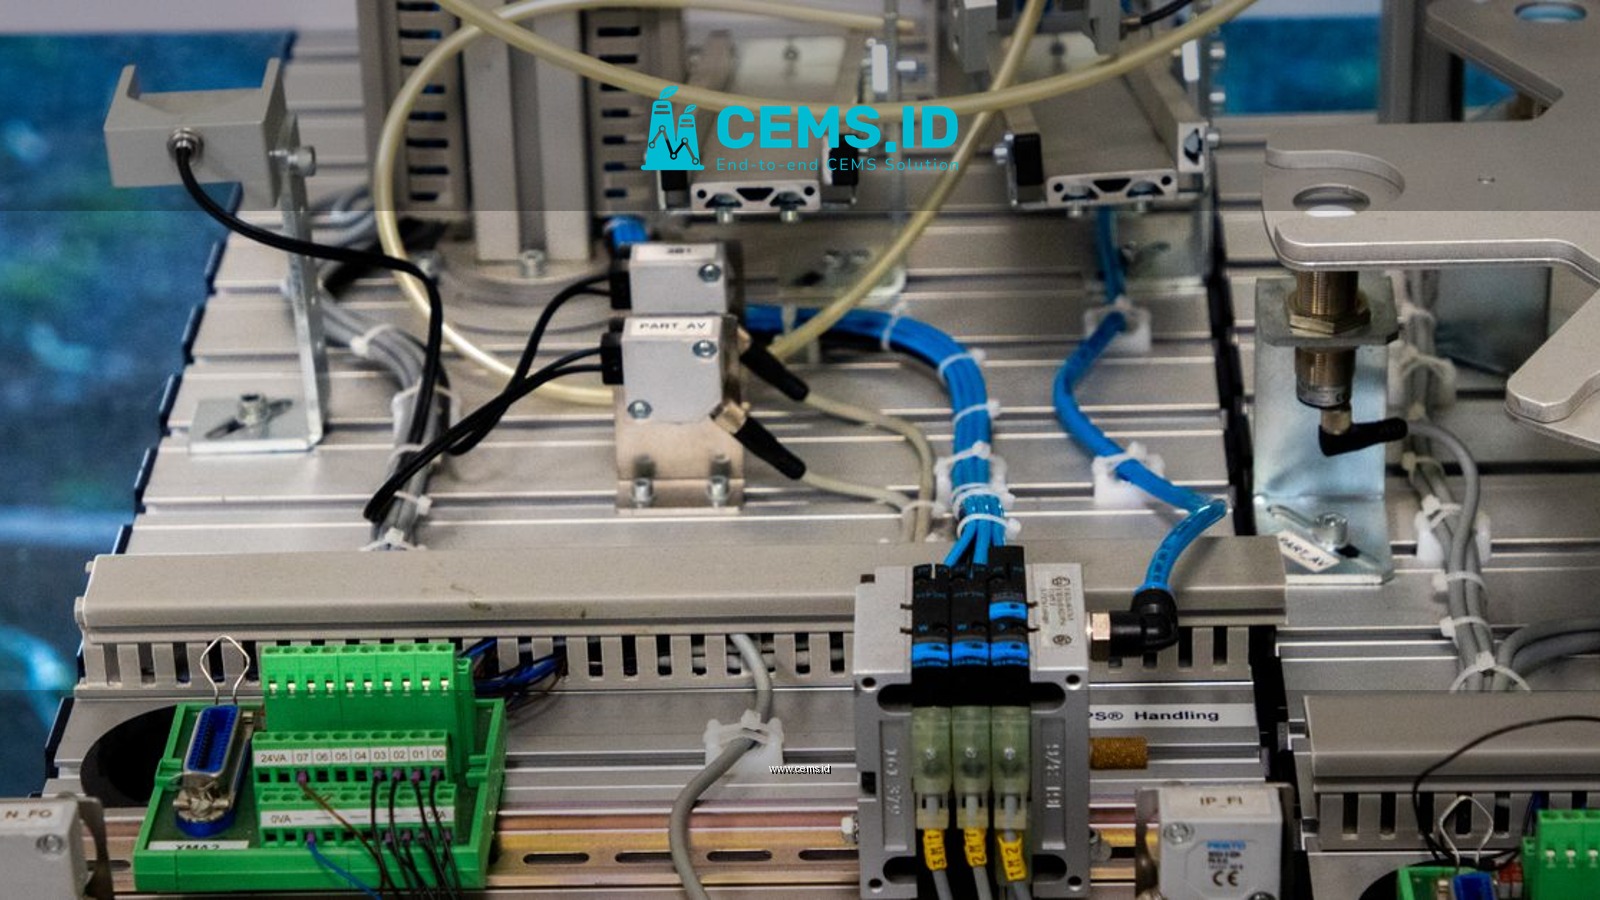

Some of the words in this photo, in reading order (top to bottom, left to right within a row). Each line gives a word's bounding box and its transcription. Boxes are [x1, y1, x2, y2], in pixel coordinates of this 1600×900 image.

[1134, 710, 1220, 722] Handling
[260, 753, 287, 763] 24VA
[296, 753, 309, 762] 07
[315, 753, 328, 762] 06
[335, 753, 348, 762] 05
[354, 752, 367, 761] 04
[373, 752, 387, 760] 03
[393, 752, 406, 760] 02
[412, 751, 425, 759] 01
[431, 750, 444, 759] 00
